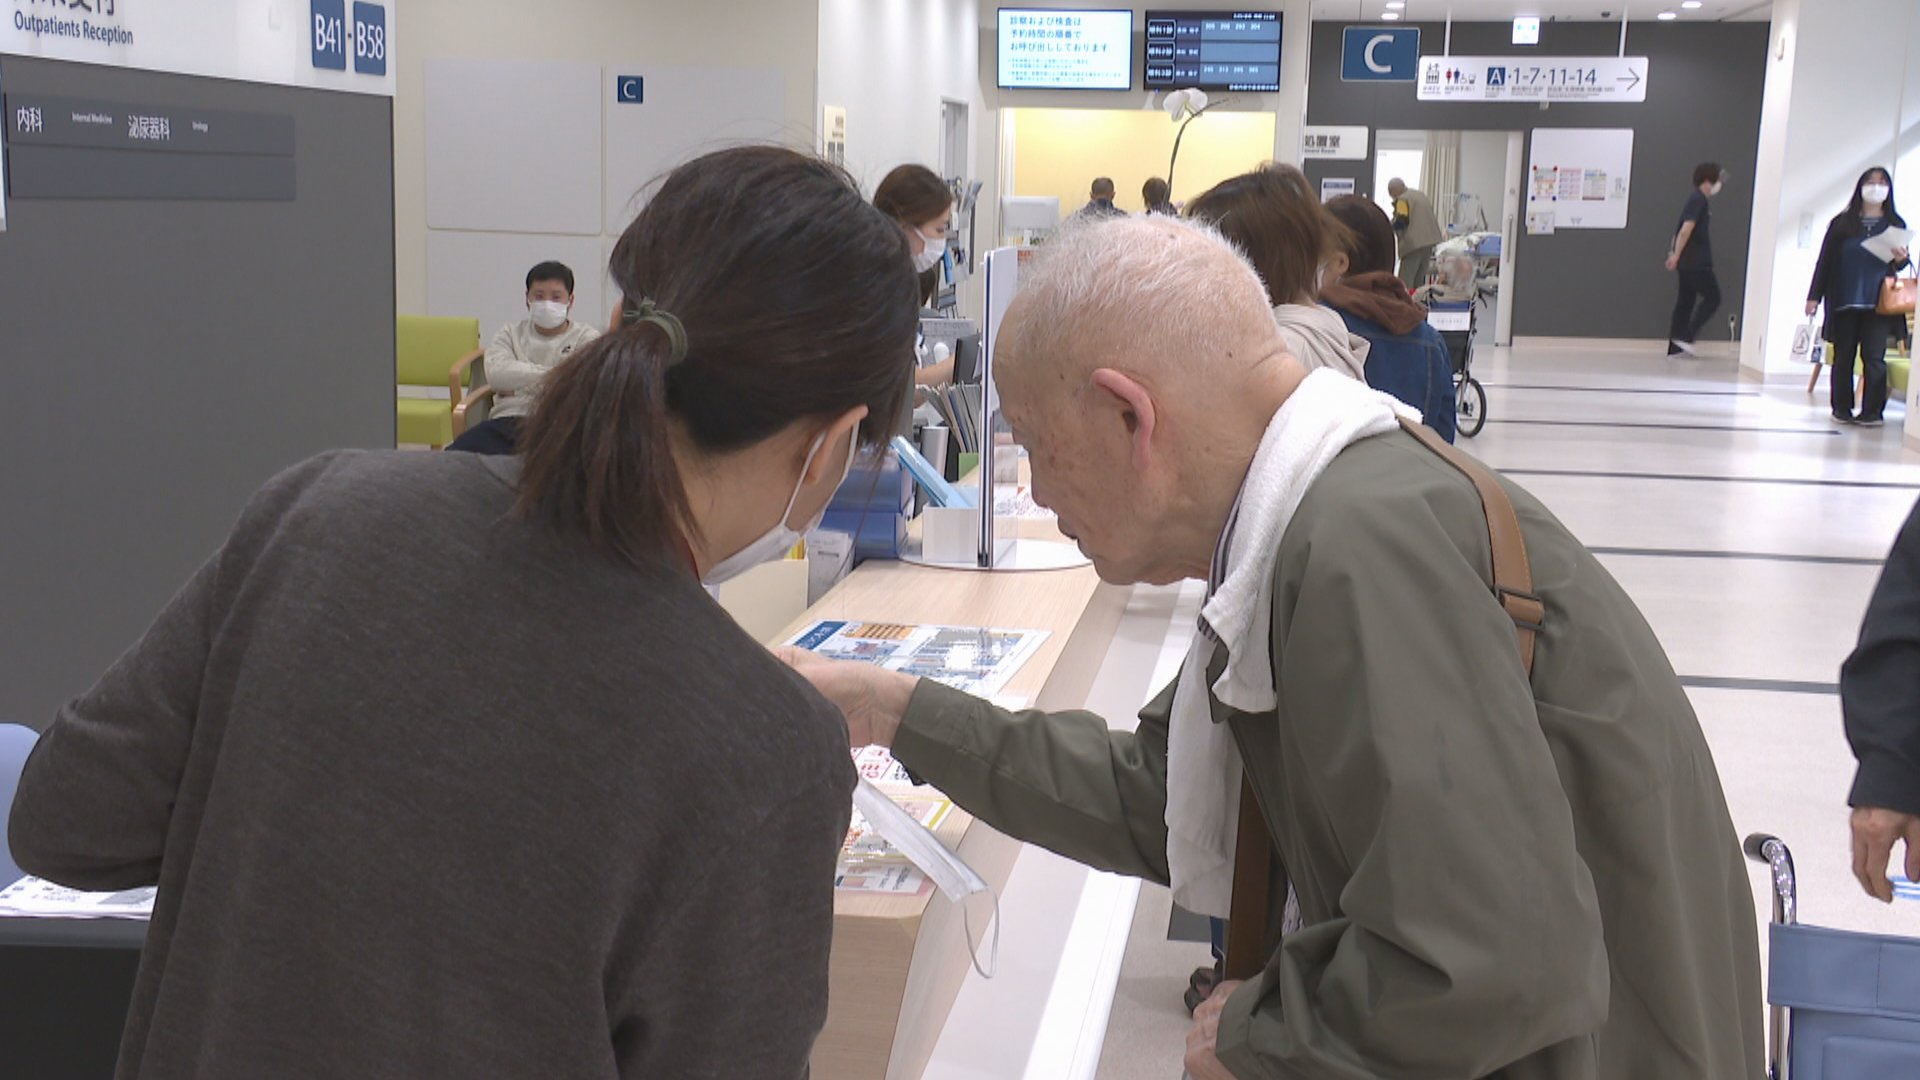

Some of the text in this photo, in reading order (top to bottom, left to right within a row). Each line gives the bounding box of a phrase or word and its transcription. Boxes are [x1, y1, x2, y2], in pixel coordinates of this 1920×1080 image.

[15, 10, 134, 46] Outpatients Reception
[315, 13, 342, 55] B41
[356, 21, 384, 60] B58
[1011, 29, 1081, 39] 予約時間の順番で
[1010, 43, 1107, 52] お呼び出ししております
[1364, 34, 1395, 73] C
[623, 80, 637, 99] C
[17, 106, 42, 133] 内科
[128, 114, 170, 140] 泌尿器科
